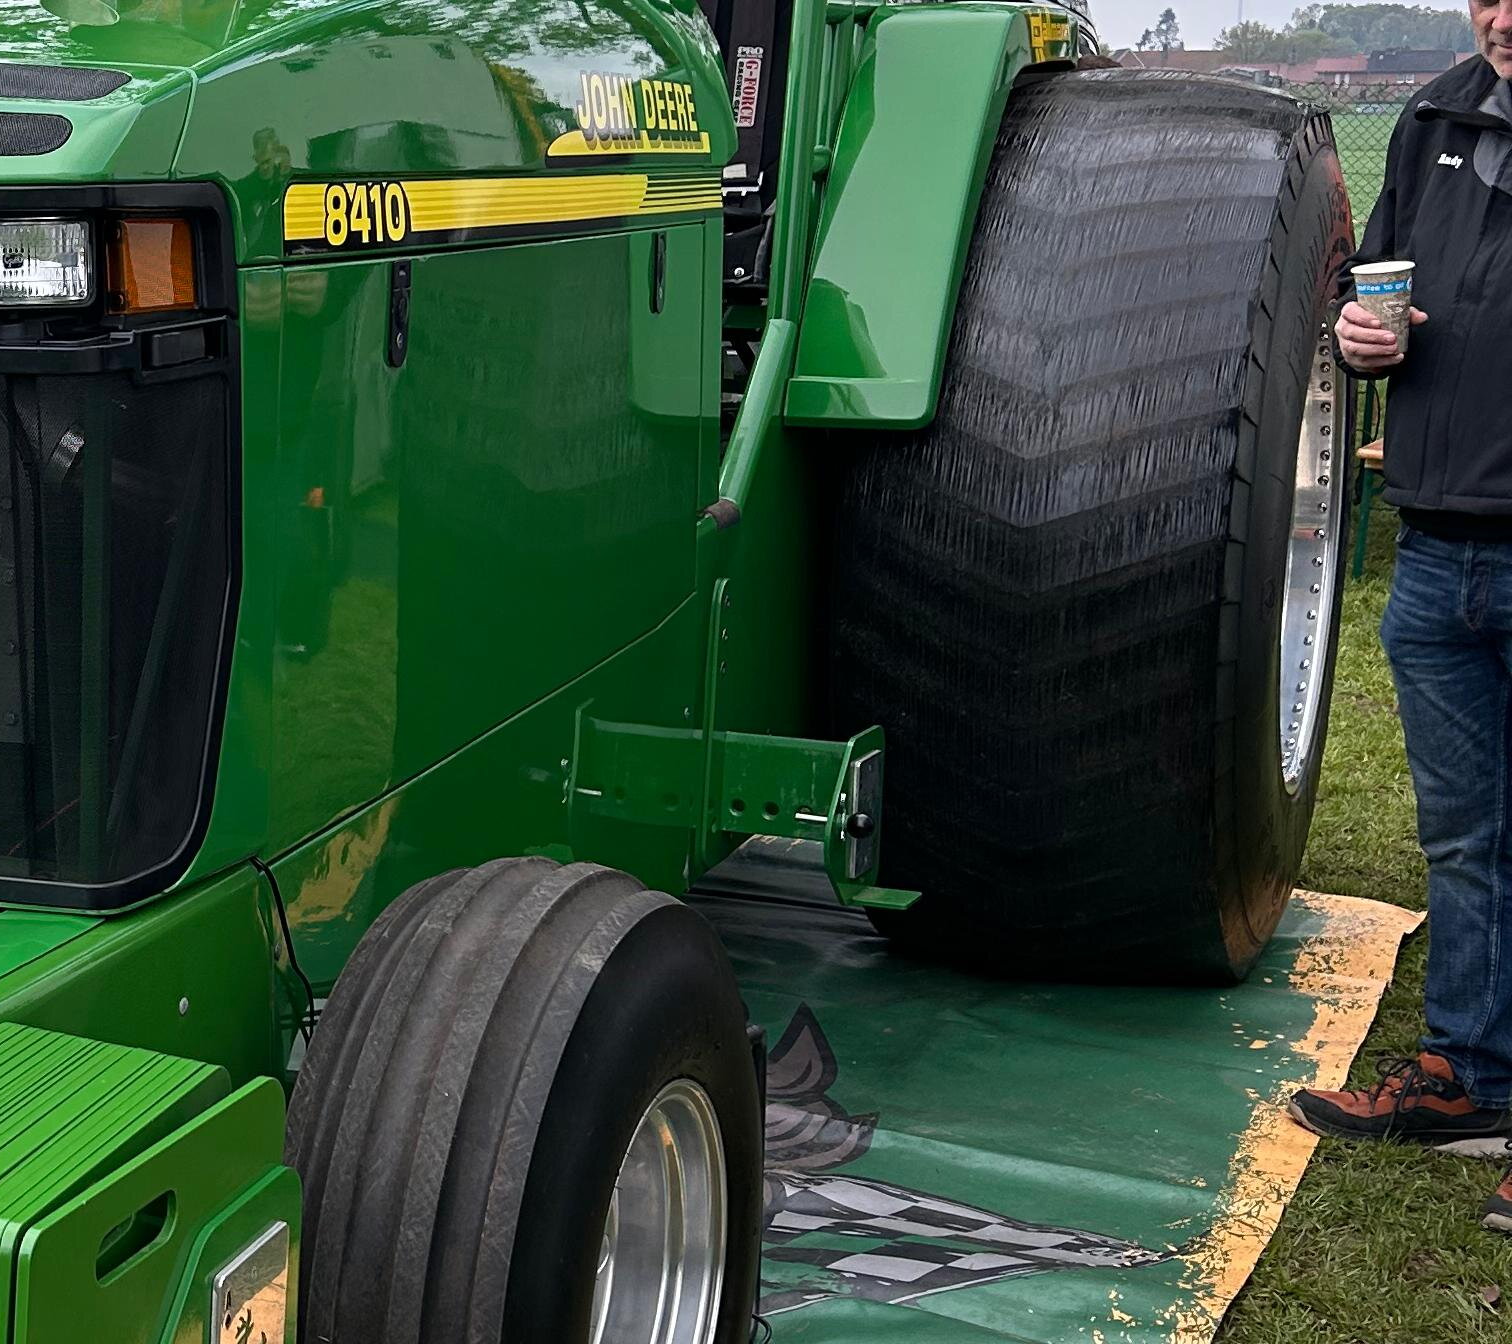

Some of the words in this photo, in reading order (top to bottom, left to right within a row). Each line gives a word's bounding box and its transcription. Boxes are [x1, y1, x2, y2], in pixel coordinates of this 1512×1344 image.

[576, 72, 637, 130] JOHN
[641, 79, 699, 132] DEERE
[739, 60, 759, 124] G-FORCE
[325, 183, 406, 246] 8410
